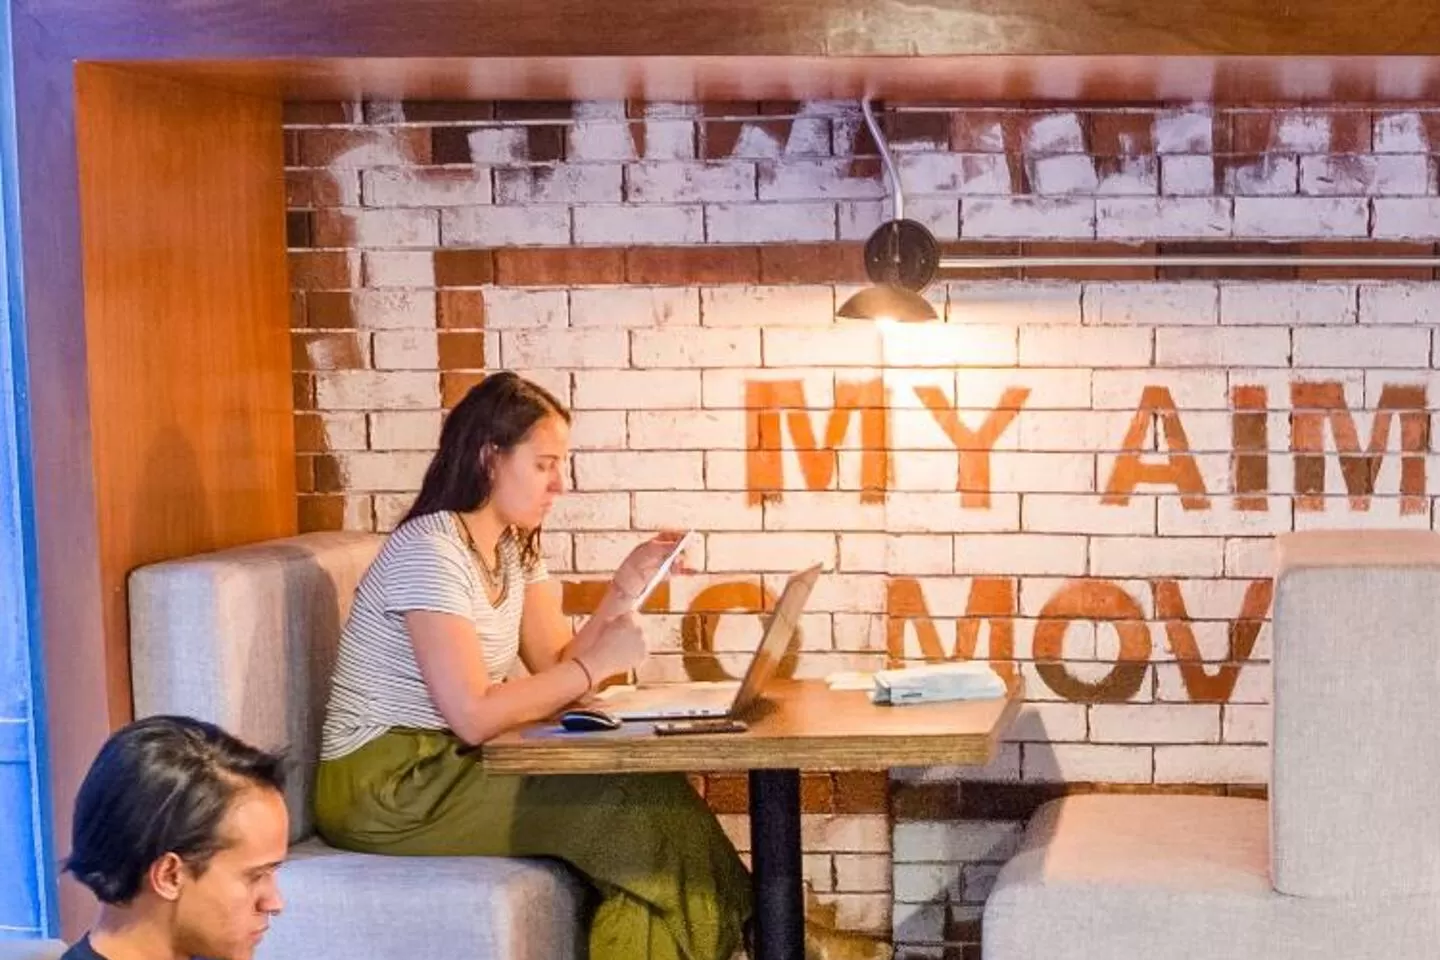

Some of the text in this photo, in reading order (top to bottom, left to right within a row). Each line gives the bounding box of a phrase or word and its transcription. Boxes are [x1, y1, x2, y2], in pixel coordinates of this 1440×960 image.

[745, 379, 1030, 510] MY
[1100, 380, 1430, 516] AIM
[887, 578, 1271, 704] MOV
